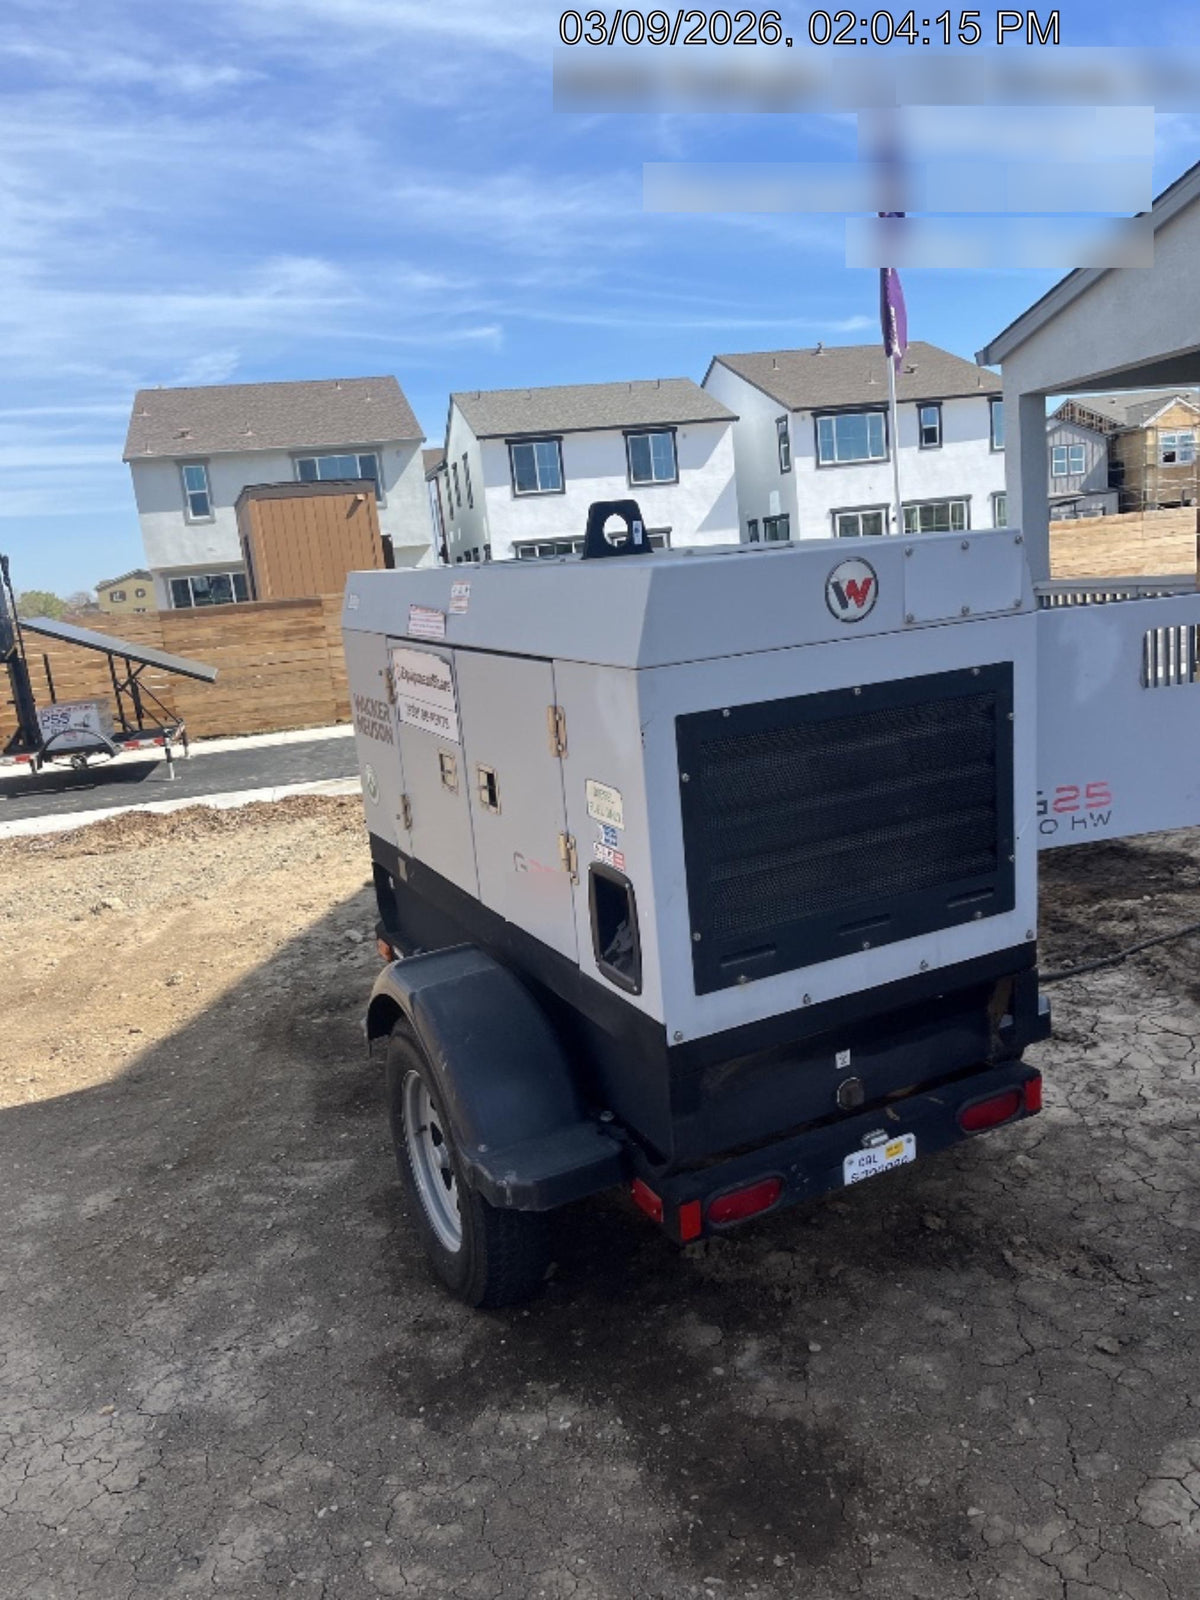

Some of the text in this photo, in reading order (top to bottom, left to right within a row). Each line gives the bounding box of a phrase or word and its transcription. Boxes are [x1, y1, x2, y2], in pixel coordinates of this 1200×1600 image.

[353, 692, 392, 724] WACKER
[355, 714, 395, 746] NEUSON
[858, 1153, 878, 1168] CAL
